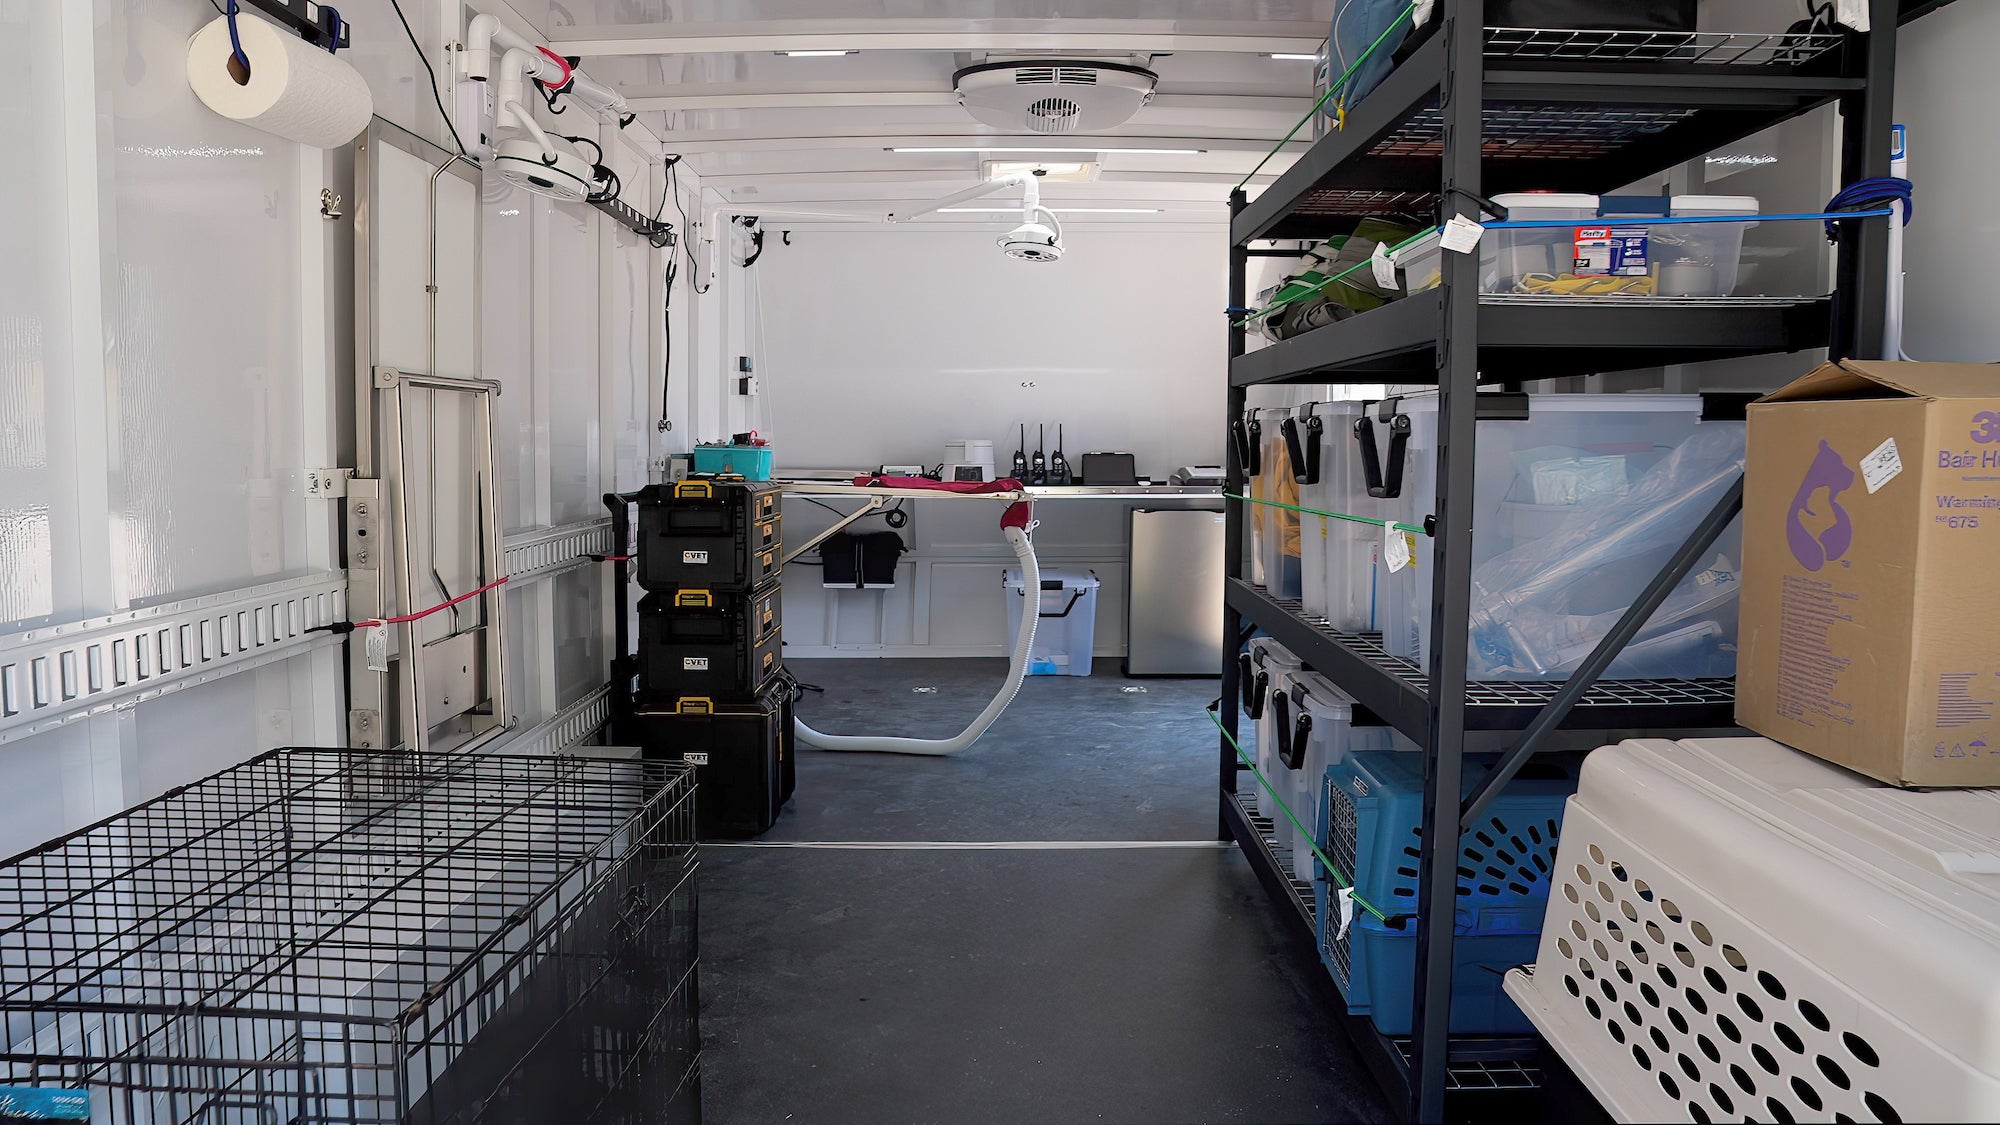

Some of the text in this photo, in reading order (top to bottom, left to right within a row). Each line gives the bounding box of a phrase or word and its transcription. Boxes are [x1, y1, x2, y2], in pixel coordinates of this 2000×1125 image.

[1970, 411, 2000, 444] 3
[1981, 450, 2000, 468] H
[1948, 515, 1979, 528] 675
